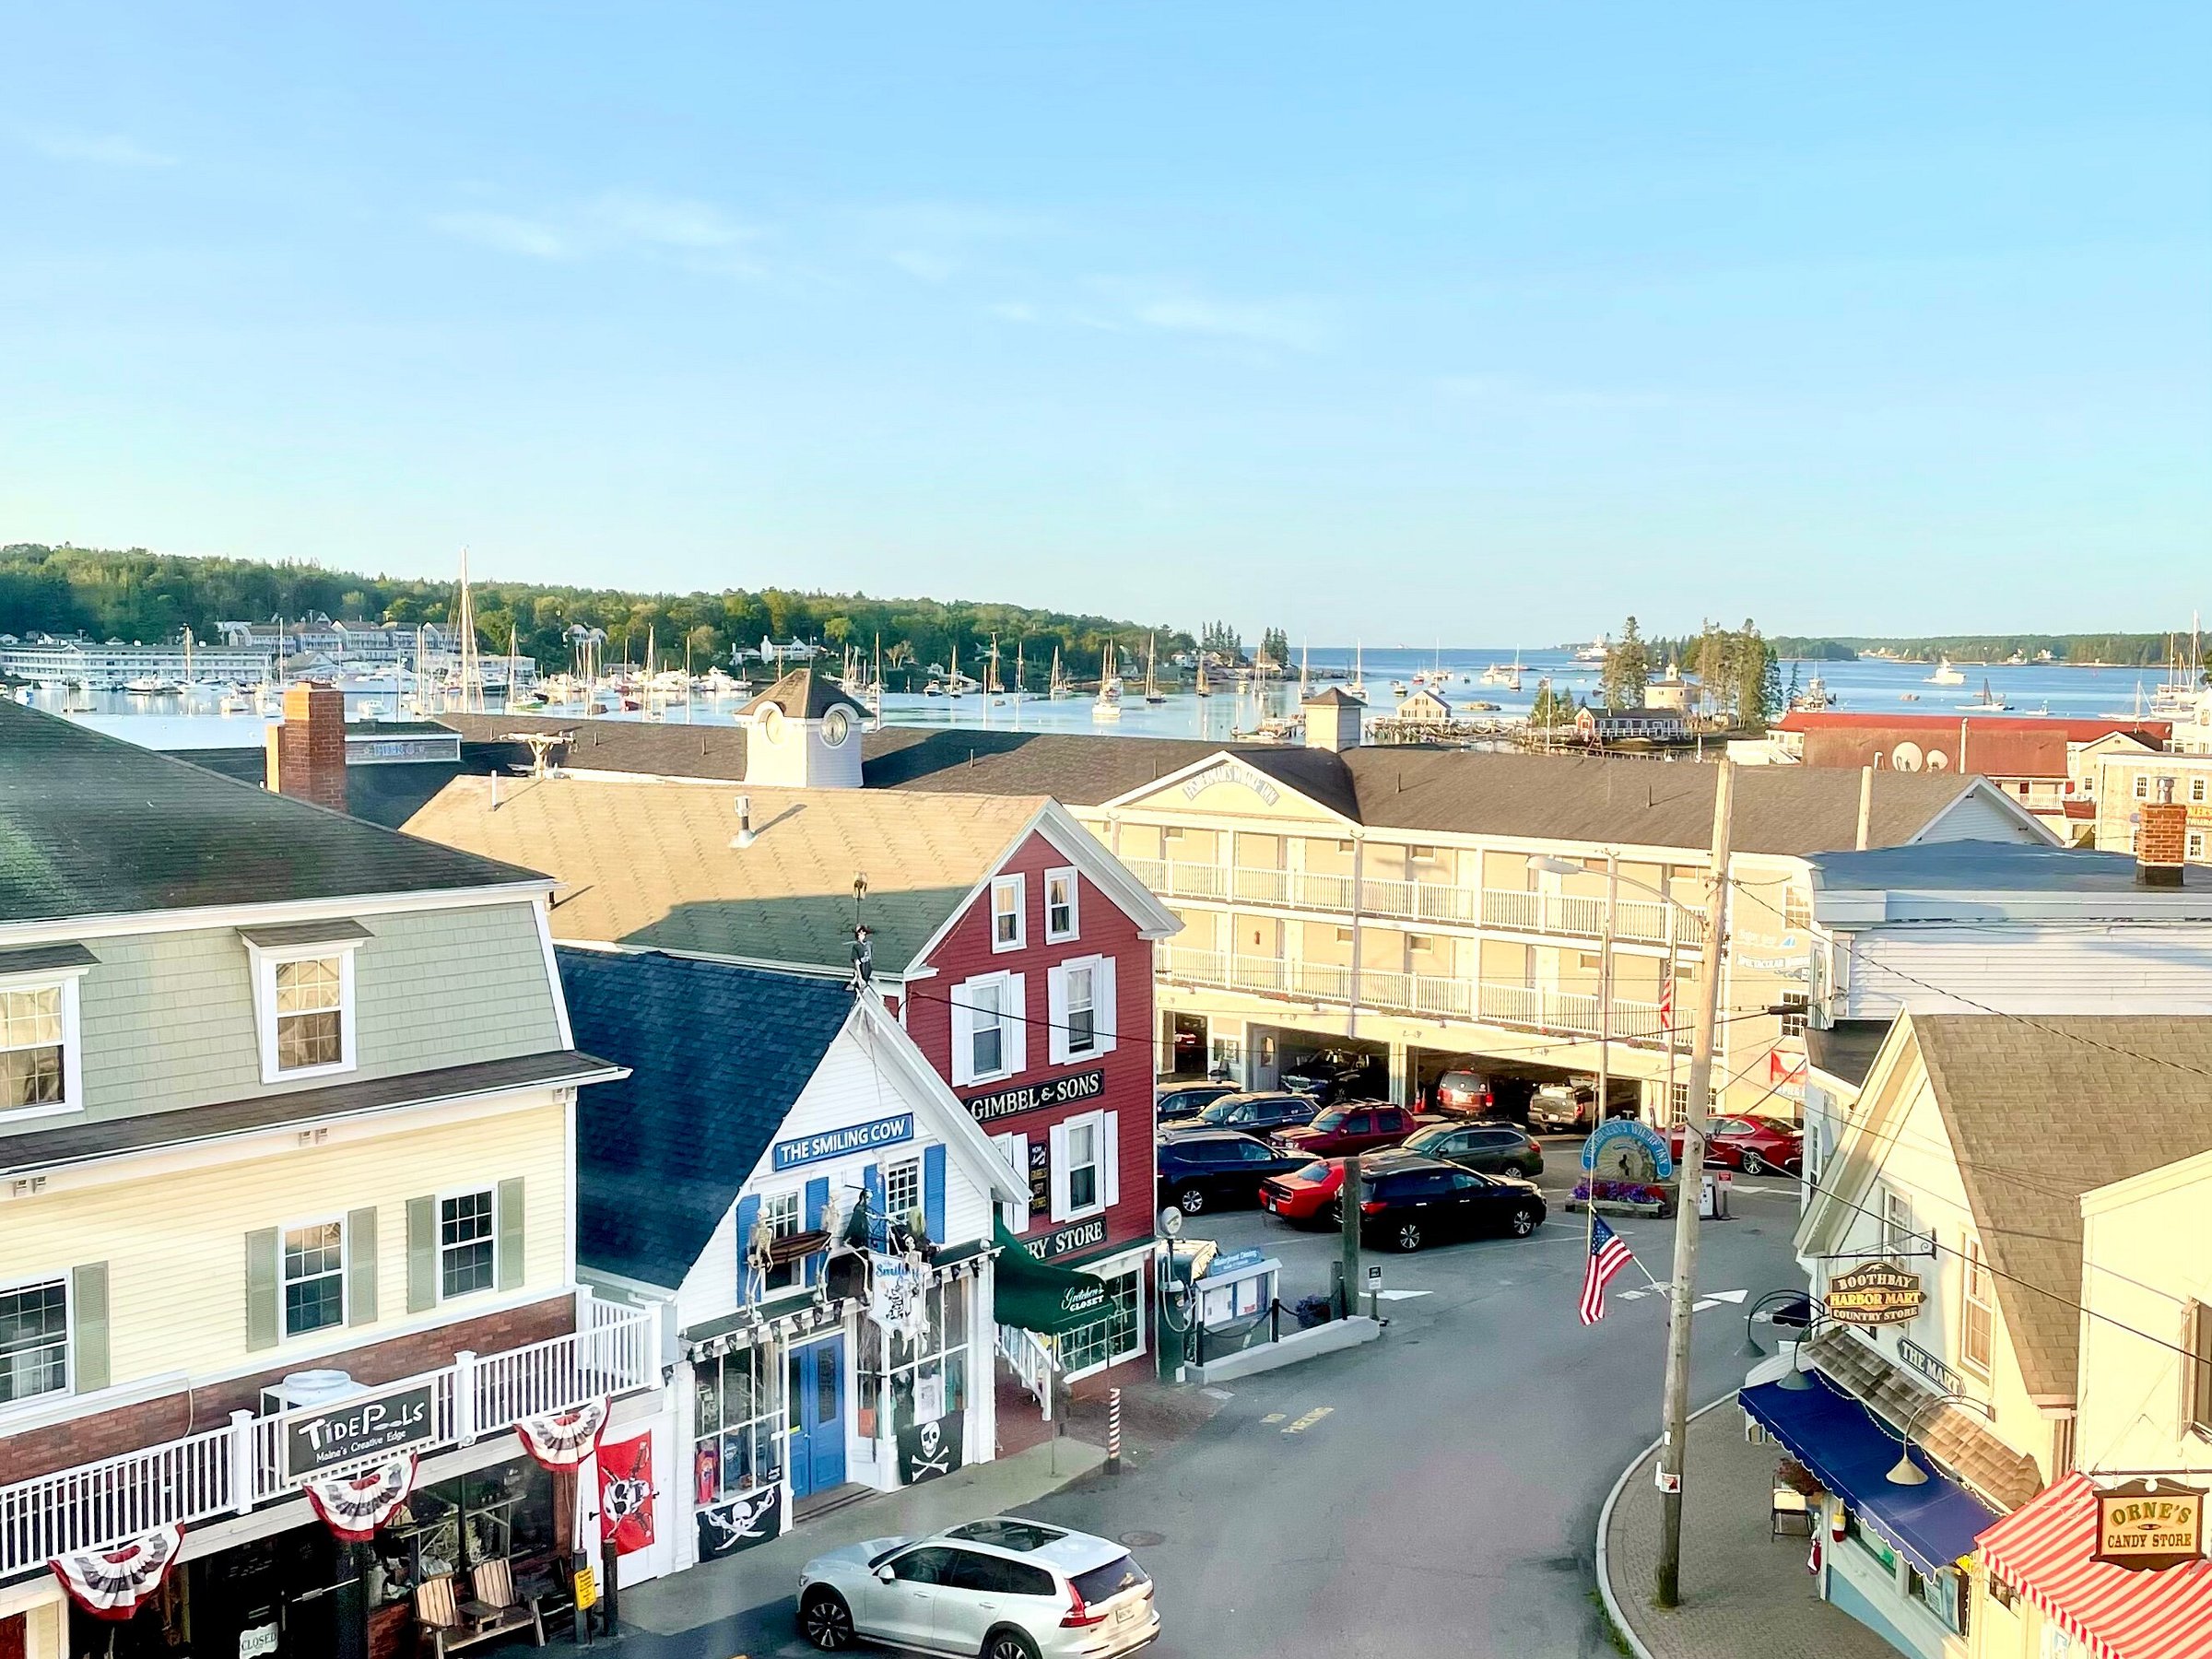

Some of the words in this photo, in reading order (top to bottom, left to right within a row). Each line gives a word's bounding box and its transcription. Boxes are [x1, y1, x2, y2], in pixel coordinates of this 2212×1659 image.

[971, 1088, 1040, 1120] GIMBEL
[1041, 1087, 1055, 1100] &
[1056, 1074, 1099, 1101] SONS
[781, 1141, 809, 1163] THE
[811, 1127, 868, 1156] SMILING
[871, 1118, 905, 1141] COW
[1630, 1124, 1659, 1147] WHARF
[1655, 1145, 1670, 1165] INN
[1055, 1221, 1102, 1253] STORE
[1838, 1274, 1913, 1290] BOOTHBAY
[1069, 1295, 1104, 1312] CLOSET
[1830, 1293, 1883, 1306] HARBOR
[1885, 1292, 1922, 1304] MART
[1833, 1309, 1882, 1322] COUNTRY
[1883, 1307, 1918, 1321] STORE
[1901, 1340, 1926, 1371] THE
[1925, 1358, 1960, 1394] MART
[316, 1446, 347, 1463] Maine's
[351, 1437, 383, 1453] Creative
[386, 1430, 406, 1442] Edge
[2111, 1501, 2192, 1526] ORNE'S
[2107, 1534, 2147, 1548] CANDY
[2152, 1533, 2192, 1547] STORE
[241, 1632, 276, 1651] CLOSED
